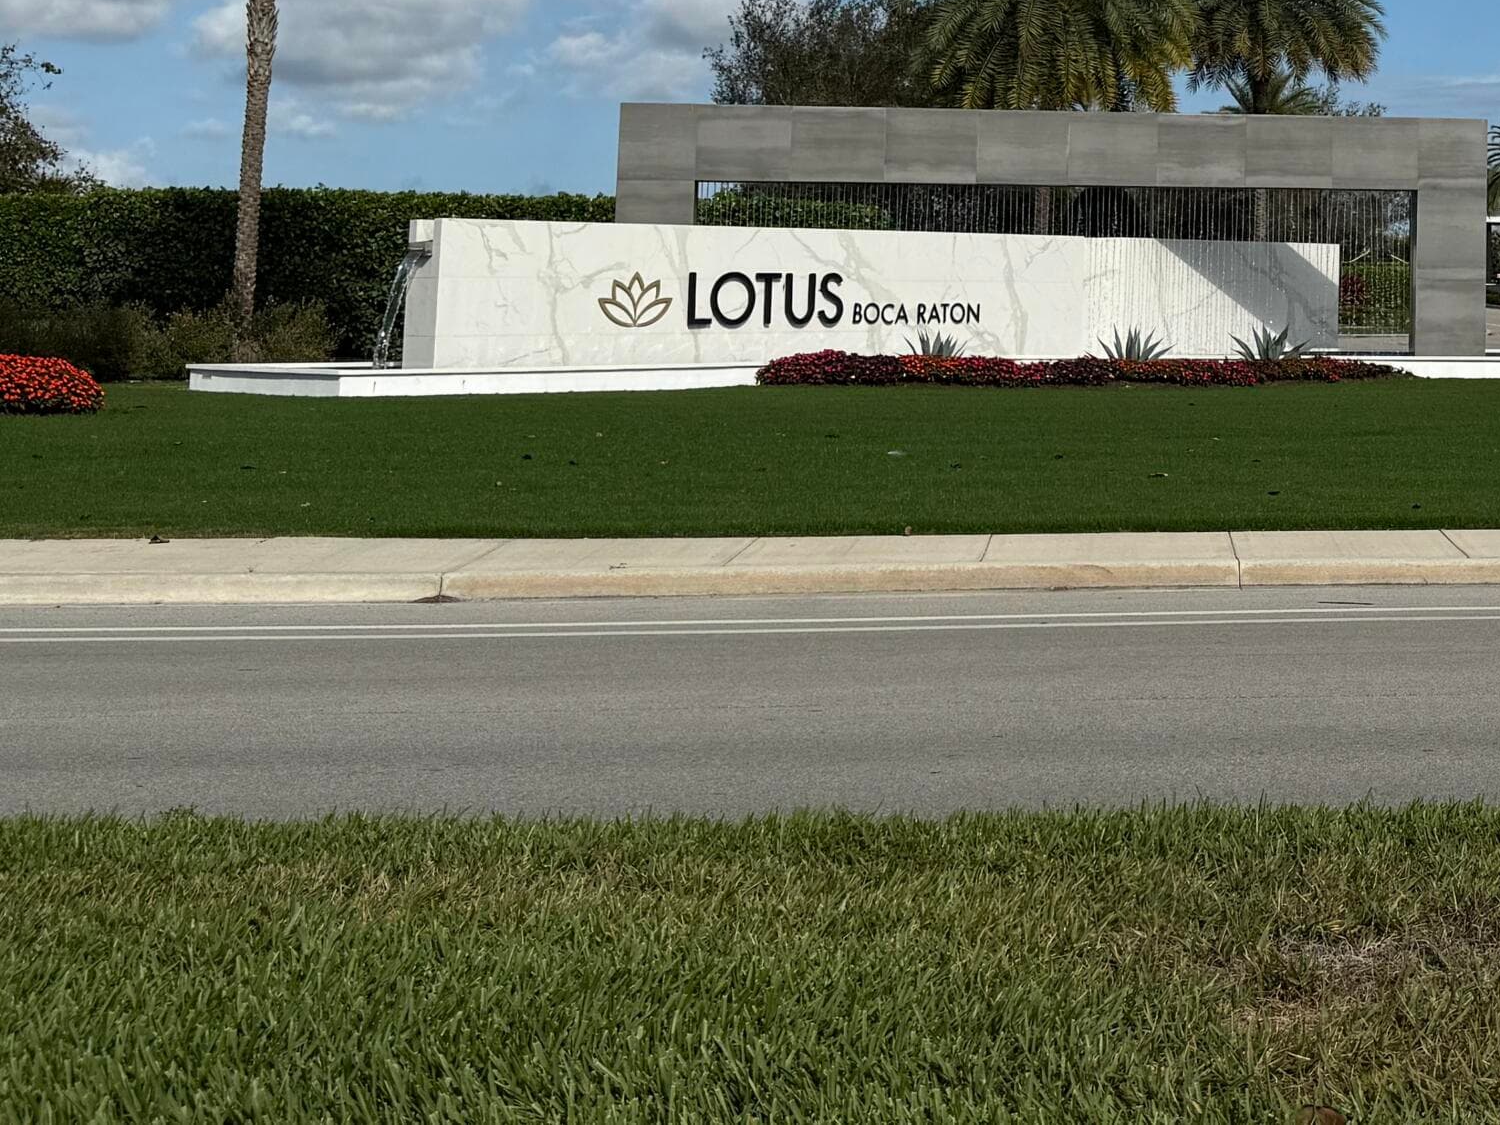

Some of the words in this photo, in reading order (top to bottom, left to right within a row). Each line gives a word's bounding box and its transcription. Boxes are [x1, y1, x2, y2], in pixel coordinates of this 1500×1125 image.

[687, 272, 844, 329] LOTUS
[852, 303, 908, 325] BOCA
[916, 303, 981, 325] RATON
